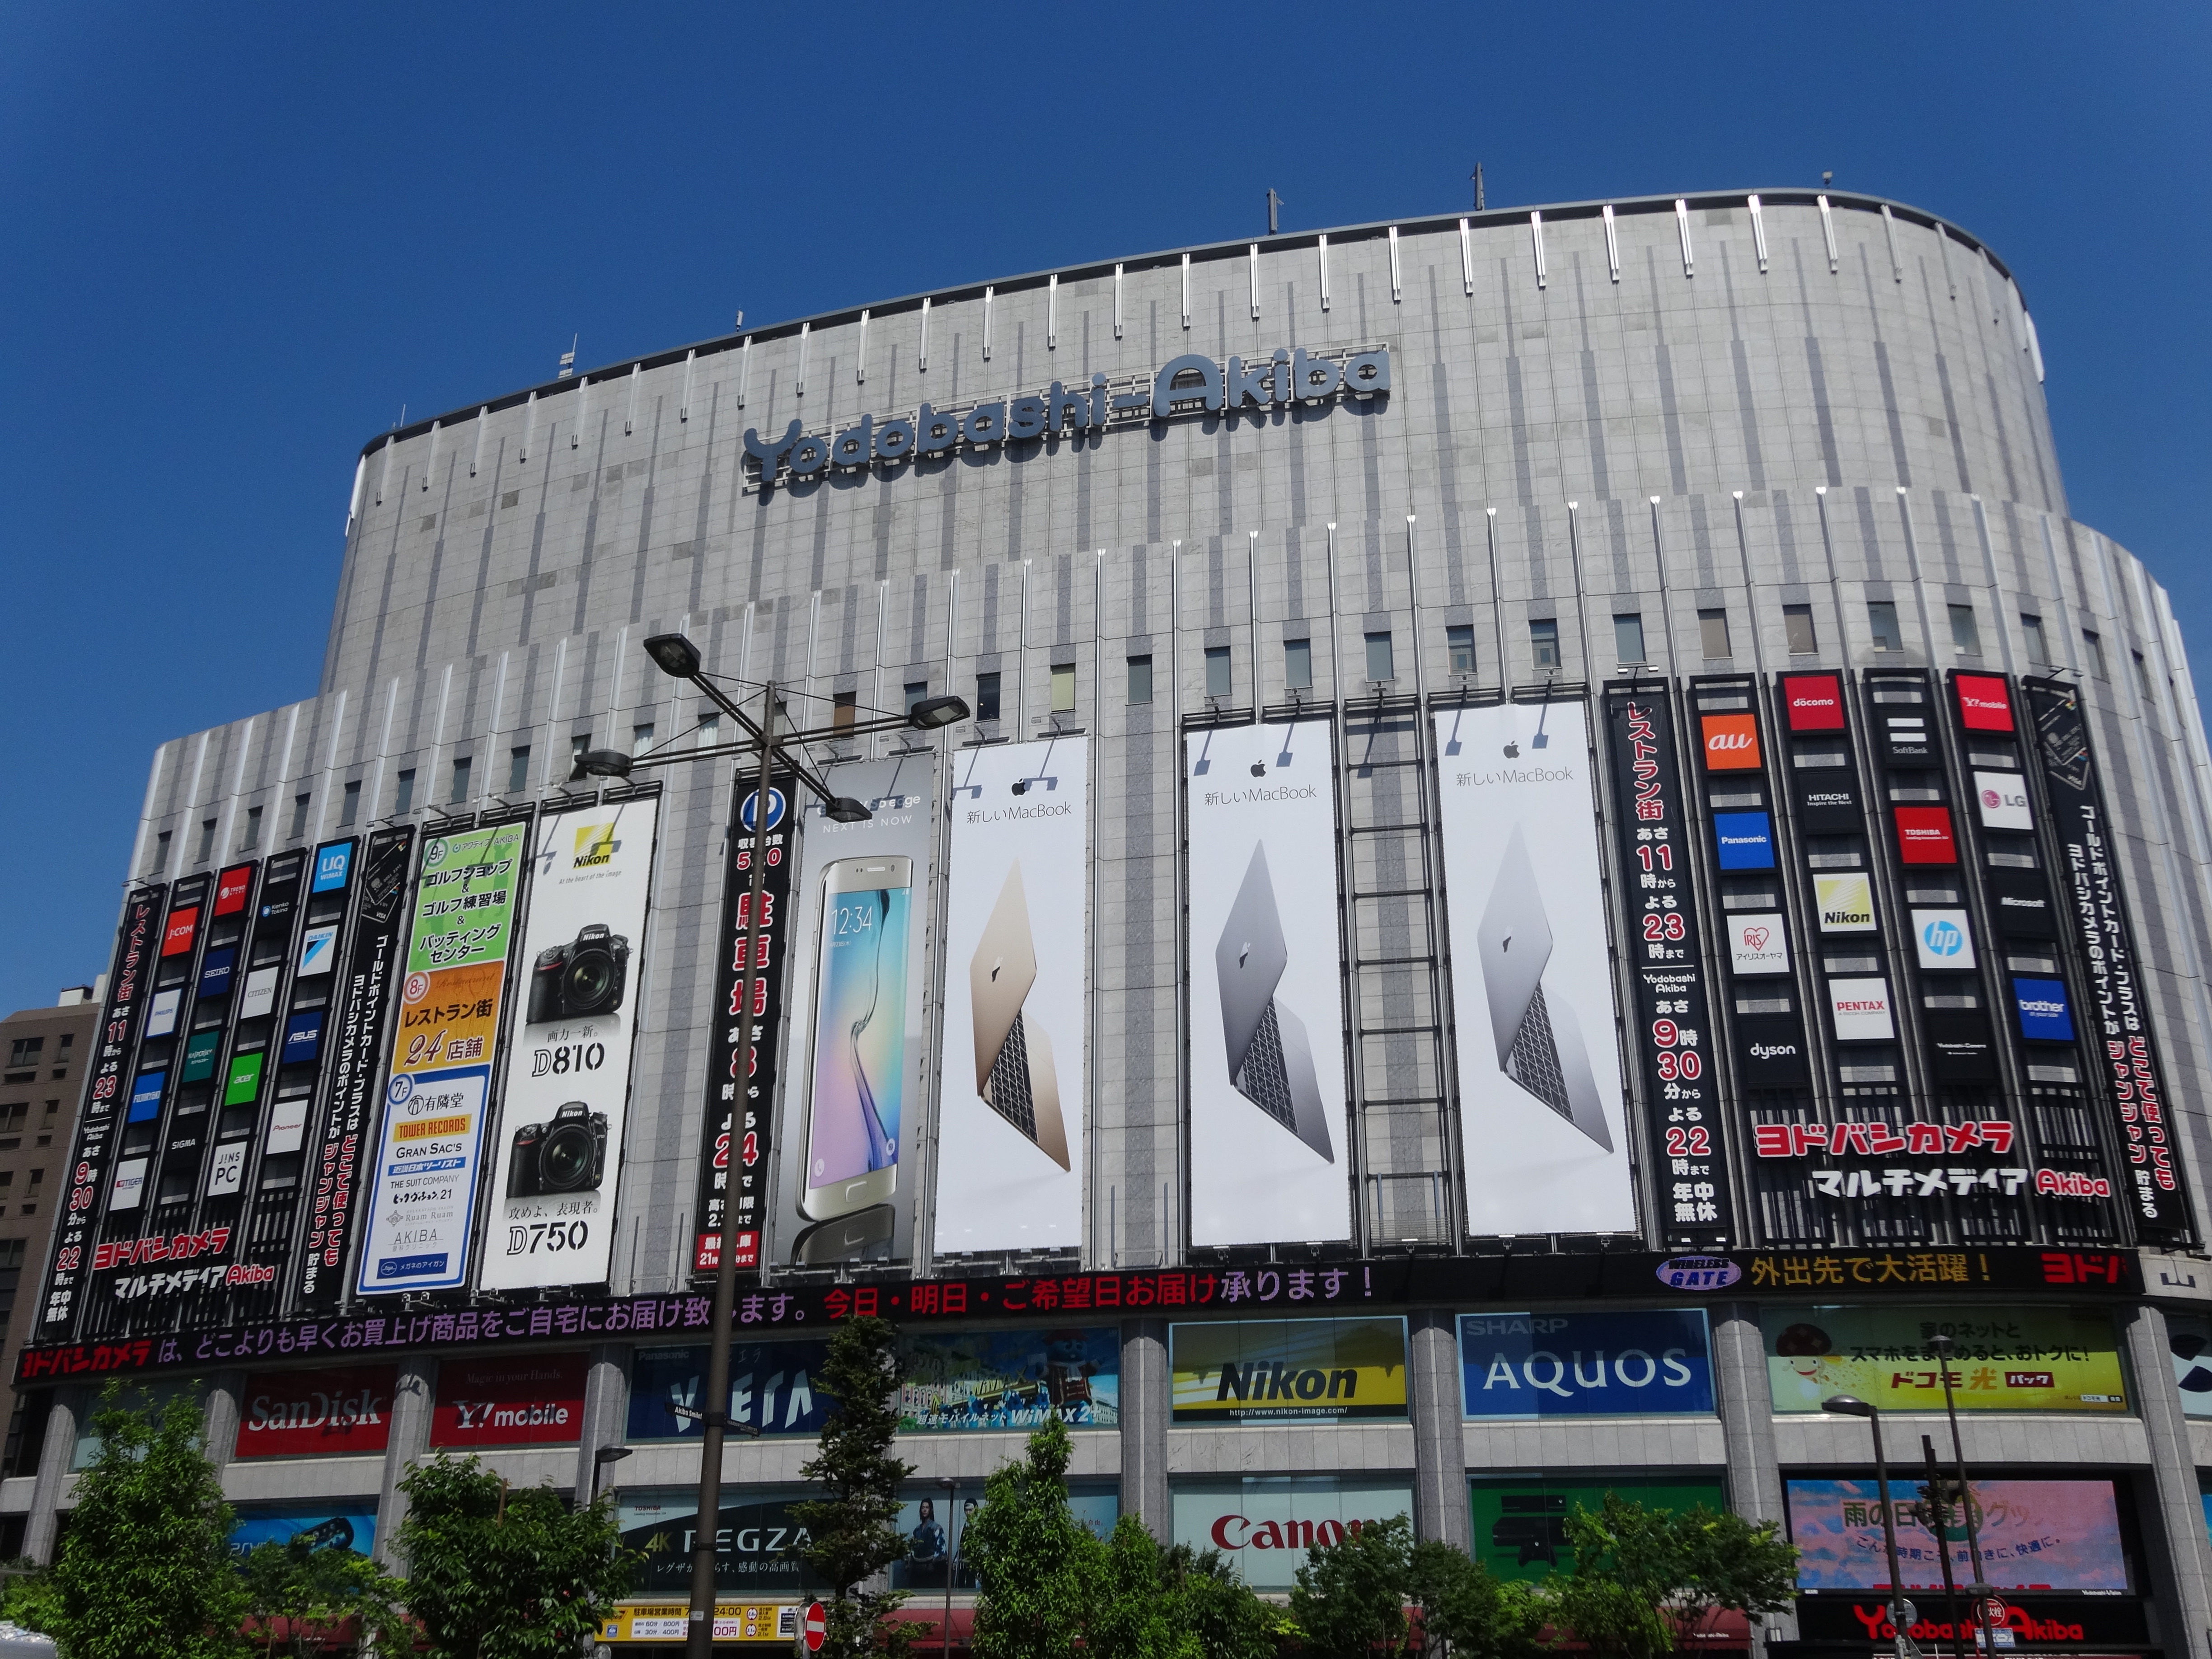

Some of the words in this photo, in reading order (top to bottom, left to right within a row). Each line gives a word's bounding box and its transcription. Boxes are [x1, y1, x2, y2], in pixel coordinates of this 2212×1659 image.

[744, 348, 1391, 482] Yodobashi-Akiba
[1794, 698, 1834, 707] docomo
[1708, 733, 1753, 750] au
[1893, 746, 1928, 755] SoftBank
[1627, 702, 1663, 821] レストラン街
[889, 796, 920, 808] edge
[1809, 793, 1849, 801] HITACHI
[2004, 794, 2026, 806] LG
[823, 822, 855, 833] NEXT
[863, 819, 874, 829] IS
[881, 815, 912, 826] NOW
[493, 834, 519, 845] AKIBA
[1636, 826, 1669, 841] あさ
[1721, 835, 1767, 845] Panasonic
[322, 855, 345, 872] UQ
[573, 853, 610, 868] Nikon
[1636, 844, 1673, 872] 11
[426, 858, 513, 886] ゴルフショップ
[605, 870, 622, 878] image
[462, 884, 469, 893] &
[1640, 873, 1676, 889] 時から
[422, 890, 508, 917] ゴルフ練習場
[1645, 895, 1678, 909] よる
[457, 915, 466, 925] &
[831, 905, 872, 935] 12:34
[1824, 912, 1870, 924] Nikon
[1643, 912, 1685, 941] 23
[308, 931, 333, 941] DAIKIN
[420, 924, 501, 950] バッティング
[583, 932, 605, 941] Nikon
[1744, 934, 1762, 946] IRIS
[117, 904, 150, 1002] レストラン街
[430, 945, 486, 964] センター
[1648, 943, 1684, 959] 時まで
[1736, 952, 1782, 961] アイリスオーヤマ
[204, 966, 230, 979] SEIKO
[1643, 973, 1696, 984] Yodobashi
[248, 987, 272, 998] CITIZEN
[1655, 983, 1687, 994] Akiba
[112, 1005, 130, 1018] あさ
[404, 998, 492, 1028] レストラン街
[1655, 999, 1689, 1014] あさ
[1837, 1001, 1884, 1011] PENTAX
[2019, 999, 2064, 1012] brother
[108, 1019, 127, 1043] 11
[289, 1030, 319, 1042] ASUS
[547, 1024, 598, 1043] 画力一新。
[1653, 1018, 1698, 1048] 9時
[532, 1042, 605, 1077] D810
[1750, 1043, 1796, 1060] dyson
[100, 1061, 117, 1074] よる
[1657, 1050, 1701, 1081] 30
[234, 1073, 254, 1084] acer
[93, 1075, 117, 1100] 23
[1664, 1083, 1701, 1100] 分から
[424, 1092, 464, 1112] 有隣堂
[561, 1109, 583, 1118] Nikon
[1668, 1107, 1702, 1122] よる
[399, 1124, 425, 1139] TOWER
[428, 1118, 466, 1134] RECORDS
[172, 1139, 195, 1150] SIGMA
[1666, 1126, 1711, 1158] 22
[1754, 1121, 2014, 1158] ヨドバシカメラ
[82, 1145, 101, 1158] あさ
[396, 1147, 427, 1158] GRAN
[429, 1142, 462, 1154] SAC'S
[1672, 1159, 1710, 1176] 時まで
[124, 1177, 143, 1187] TIGER
[215, 1166, 237, 1186] PC
[390, 1180, 404, 1189] THE
[406, 1178, 422, 1187] SUIT
[423, 1174, 459, 1186] COMPANY
[1812, 1168, 2028, 1198] マルチメディア
[2035, 1168, 2111, 1198] Akiba
[70, 1186, 93, 1211] 30
[1673, 1182, 1714, 1201] 年中
[1674, 1202, 1718, 1222] 無休
[64, 1230, 82, 1244] よる
[394, 1228, 438, 1245] AKIBA
[506, 1220, 589, 1256] D750
[94, 1227, 231, 1270] ヨドバシカメラ
[56, 1246, 81, 1271] 22
[115, 1265, 227, 1299] マルチメディア
[226, 1264, 274, 1286] Akiba
[1670, 1271, 1728, 1286] GATE
[50, 1290, 71, 1306] 年中
[1466, 1318, 1568, 1336] SHARP
[1483, 1348, 1691, 1397] AQUOS
[1217, 1361, 1358, 1401] Nikon
[248, 1389, 383, 1431] SanDisk
[675, 1406, 689, 1416] Akiba
[1230, 1407, 1348, 1418] http://www.nikon-image.com/
[645, 1532, 672, 1552] 4K
